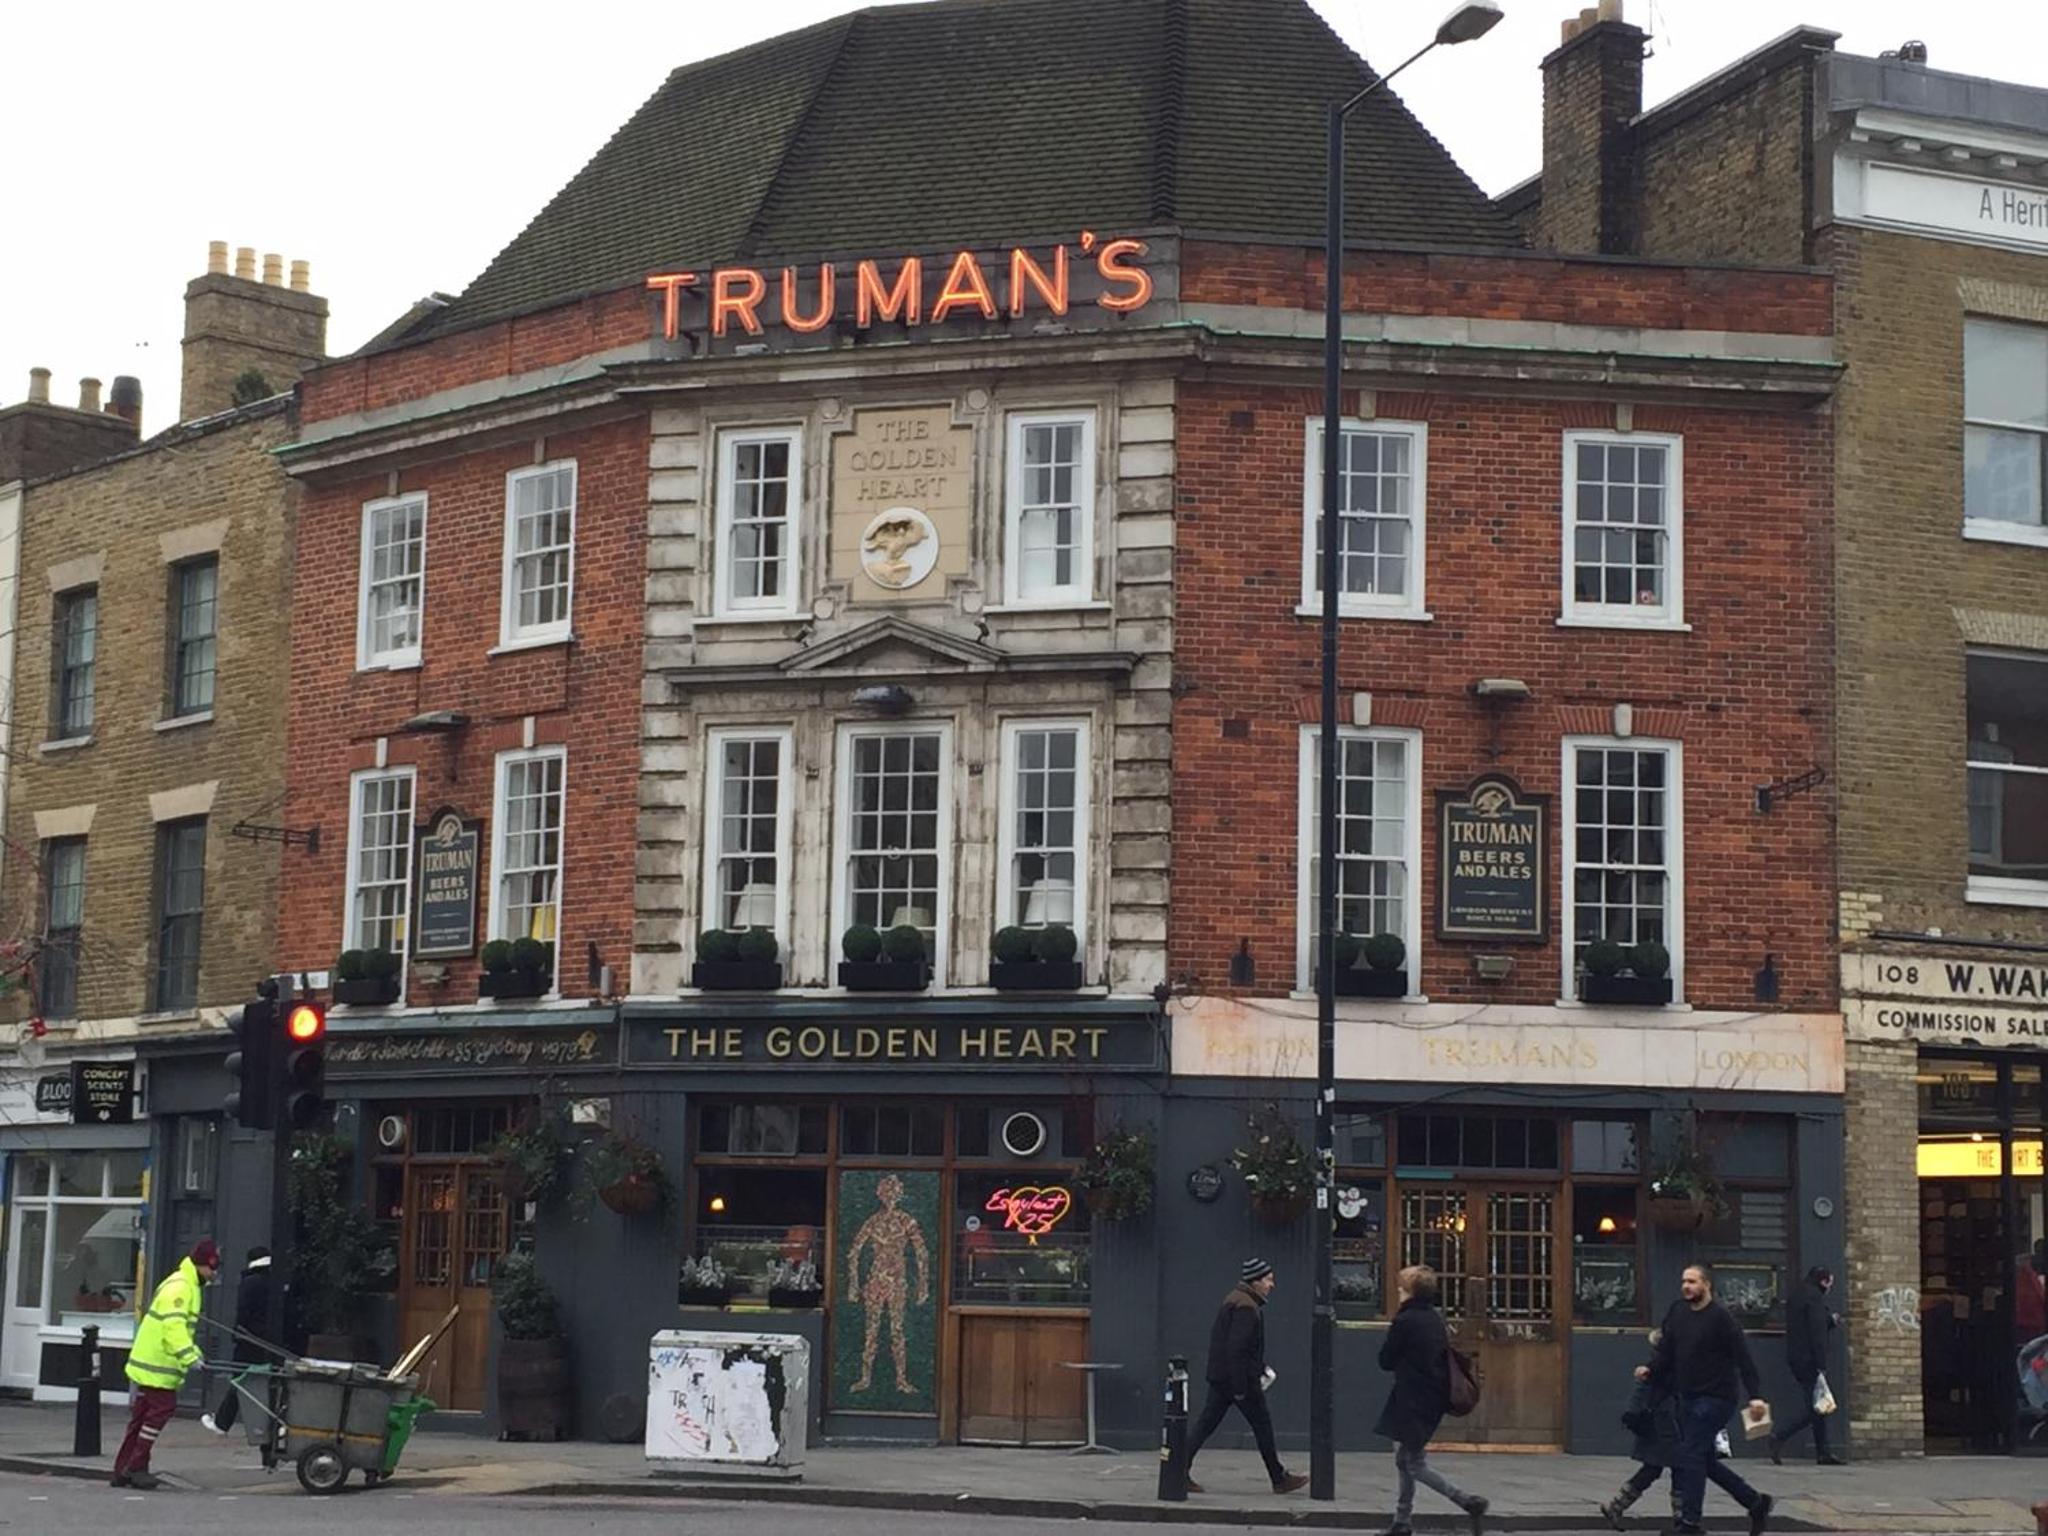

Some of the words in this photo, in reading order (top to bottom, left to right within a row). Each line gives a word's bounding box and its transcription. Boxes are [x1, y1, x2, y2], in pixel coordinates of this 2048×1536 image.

[1979, 188, 1993, 219] A
[647, 229, 1155, 341] TRUMAN'S
[877, 419, 930, 443] THE
[850, 444, 958, 472] GOLDEN
[856, 477, 948, 502] HEART
[1451, 821, 1533, 844] TRUMAN
[425, 848, 472, 872] TRUMAN
[1459, 850, 1525, 865] BEERS
[1454, 864, 1487, 878] AND
[1489, 866, 1532, 879] ALES
[430, 875, 465, 891] BEERS
[1877, 963, 1919, 985] 108
[1877, 1009, 1996, 1033] COMMISSION
[663, 1028, 743, 1057] THE
[765, 1026, 938, 1058] GOLDEN
[959, 1028, 1108, 1058] HEART
[82, 1069, 128, 1079] CONCEPT
[41, 1082, 71, 1100] BLOO
[87, 1081, 124, 1090] SCENTS
[89, 1092, 120, 1101] STORE
[1977, 1149, 1995, 1168] THE
